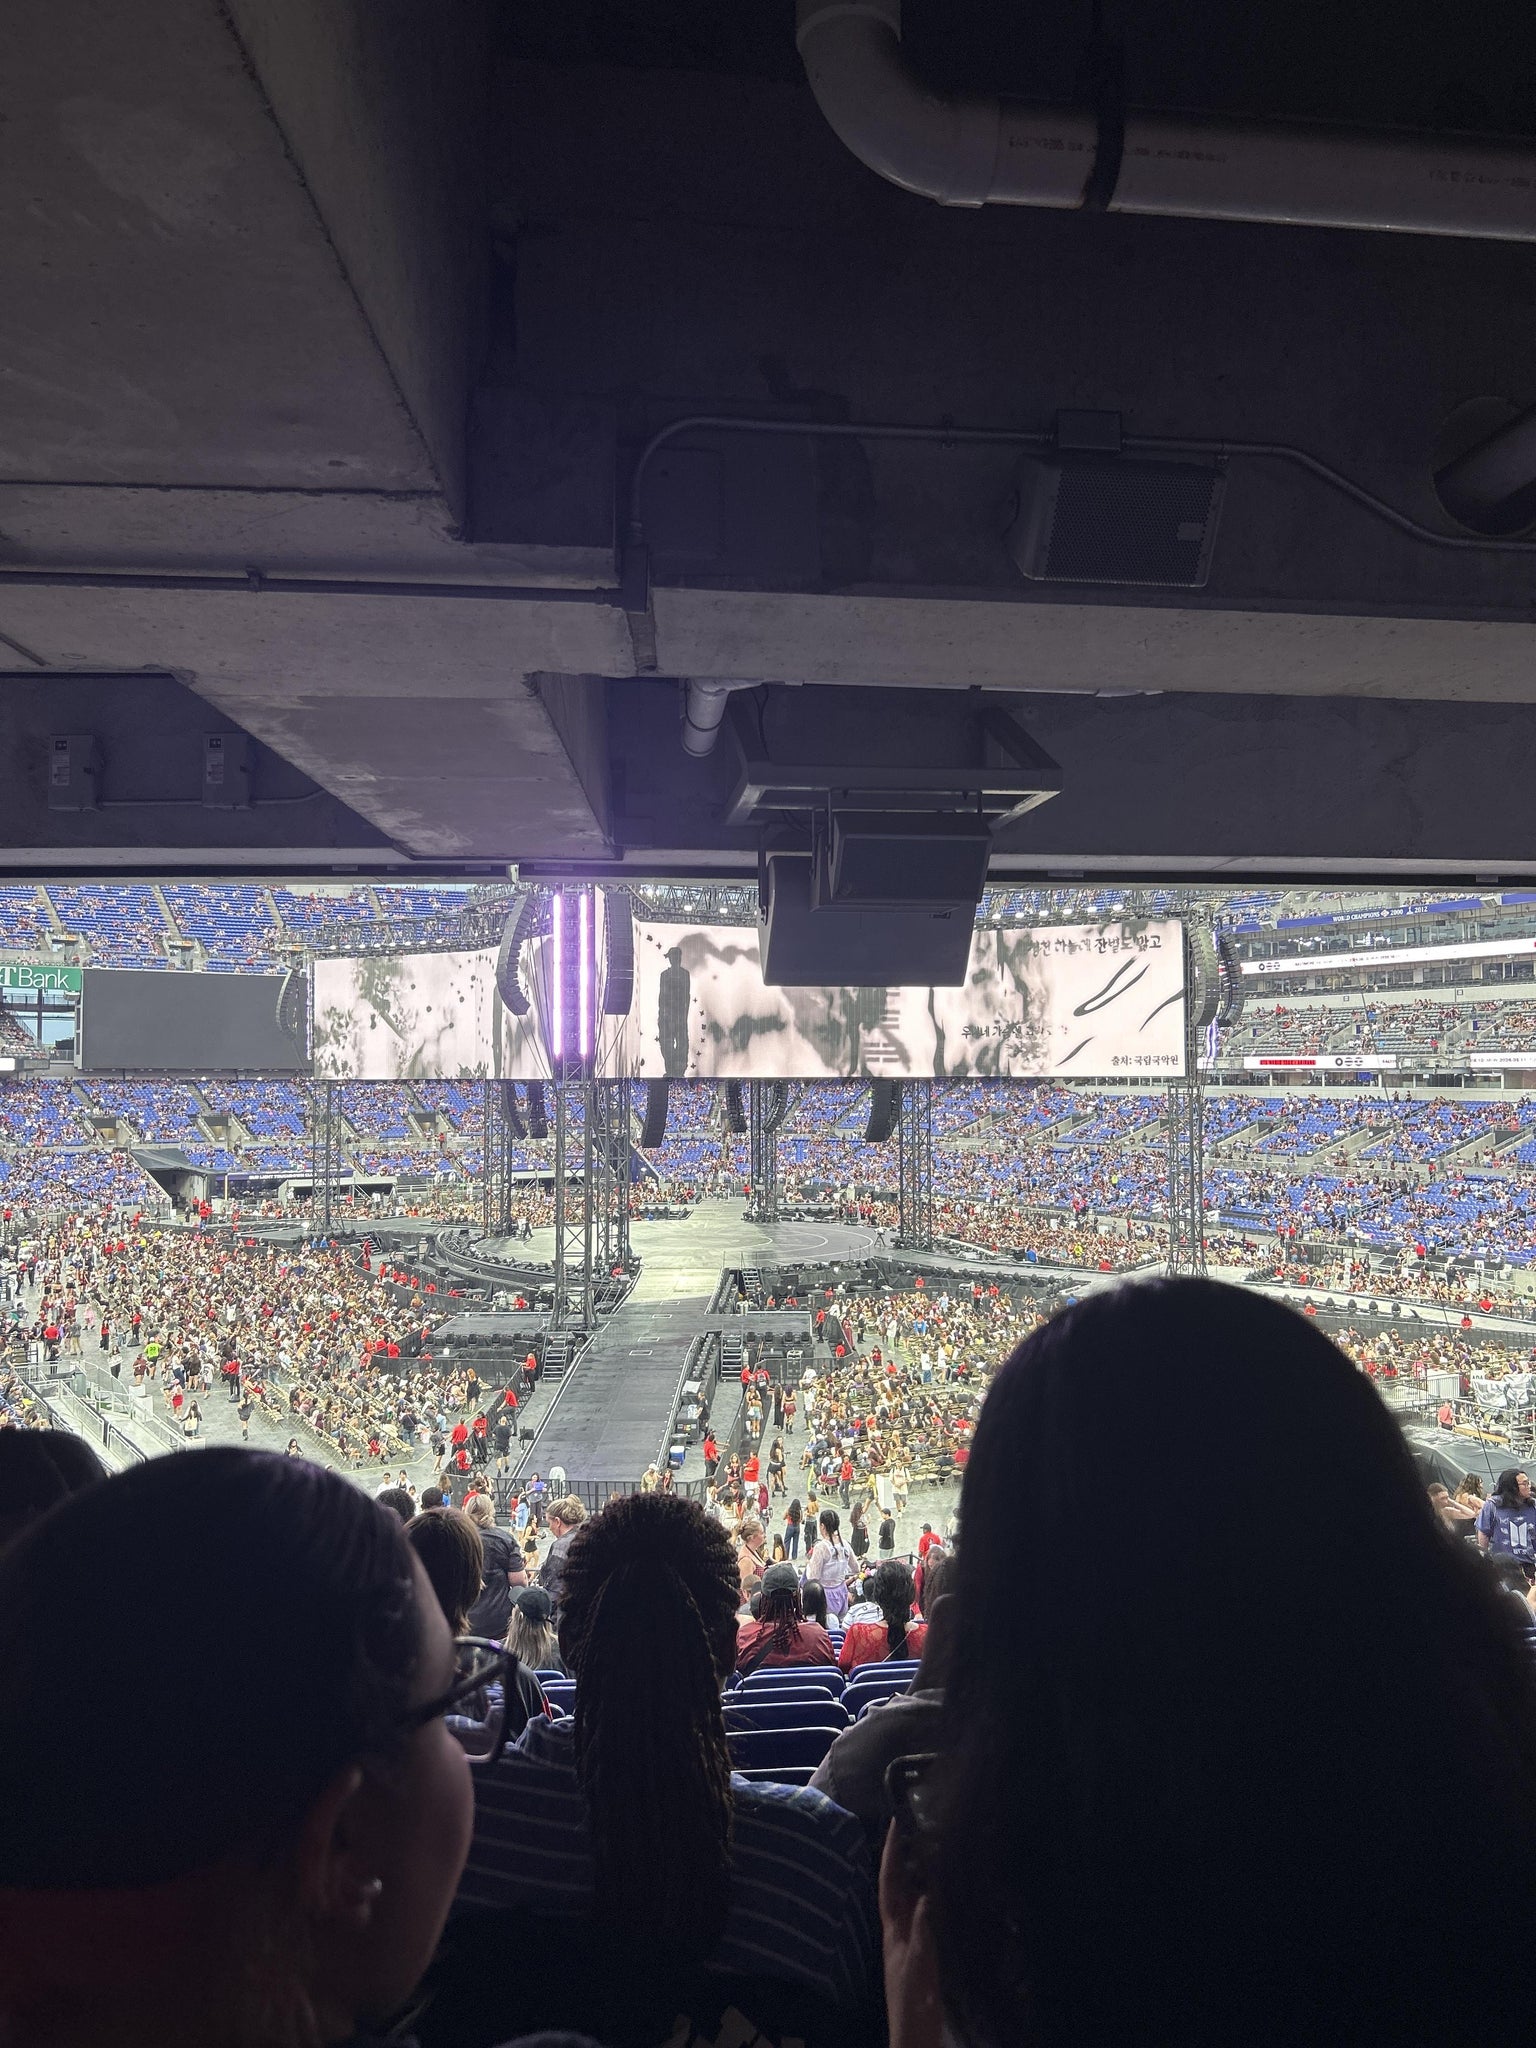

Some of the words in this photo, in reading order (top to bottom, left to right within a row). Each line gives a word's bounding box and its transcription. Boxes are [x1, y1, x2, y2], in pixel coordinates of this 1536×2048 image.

[1332, 914, 1350, 922] WORLD
[1351, 911, 1380, 920] CHAMPIONS
[1390, 908, 1404, 916] 2000
[1414, 906, 1428, 914] 2012
[0, 966, 16, 987] T
[18, 967, 70, 989] Bank
[1134, 1054, 1179, 1066] 국립국악원
